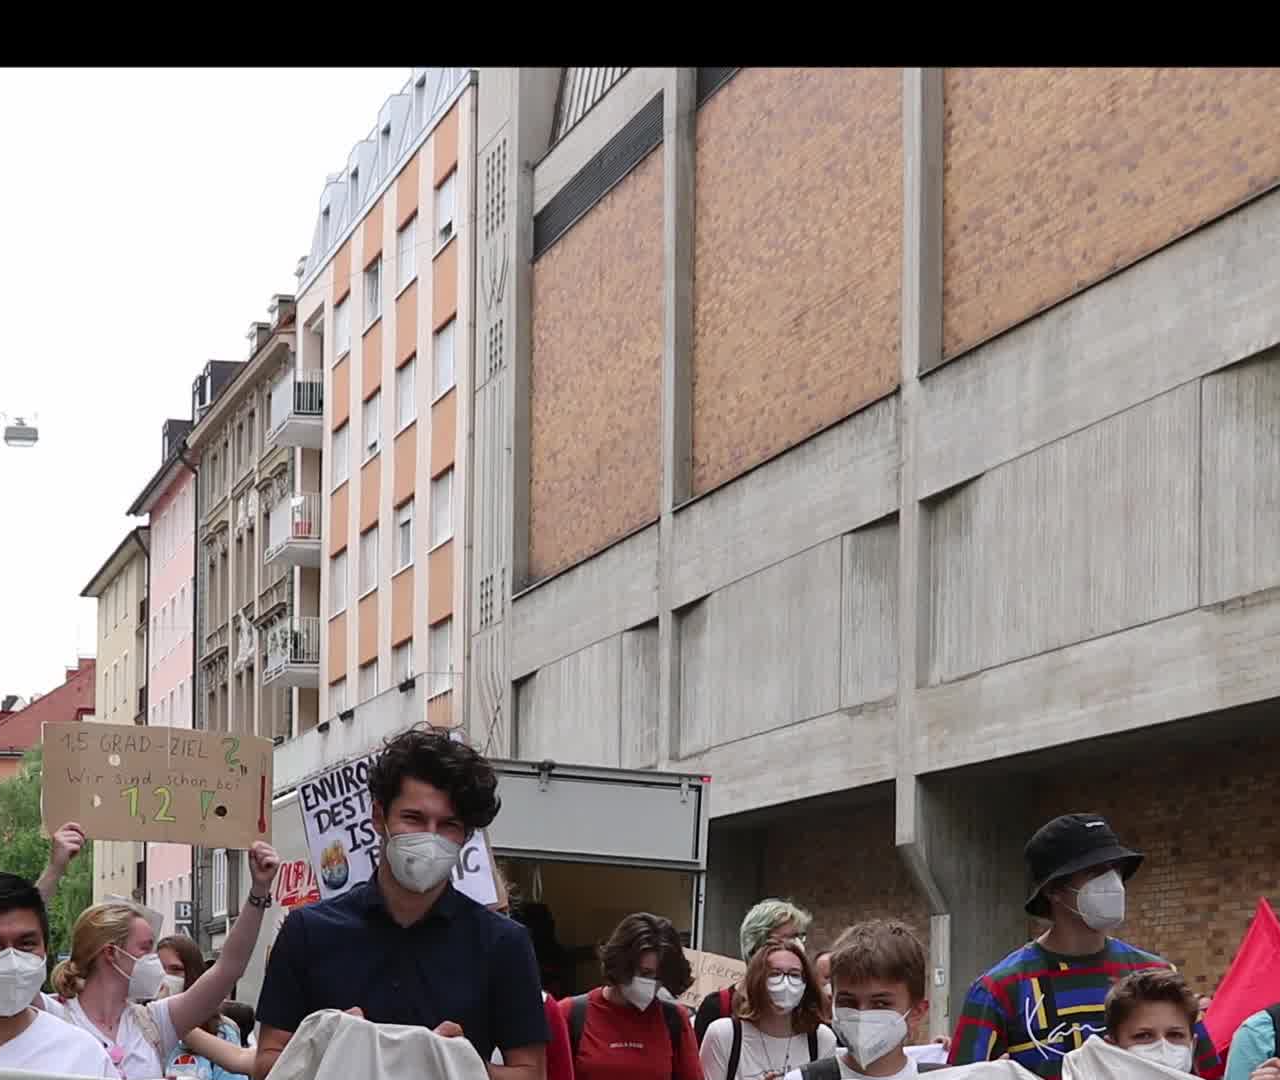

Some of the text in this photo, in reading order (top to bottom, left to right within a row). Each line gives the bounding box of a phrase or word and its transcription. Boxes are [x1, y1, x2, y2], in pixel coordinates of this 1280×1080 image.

[66, 768, 103, 785] Wir
[120, 783, 177, 824] 1,2
[344, 818, 377, 853] IS
